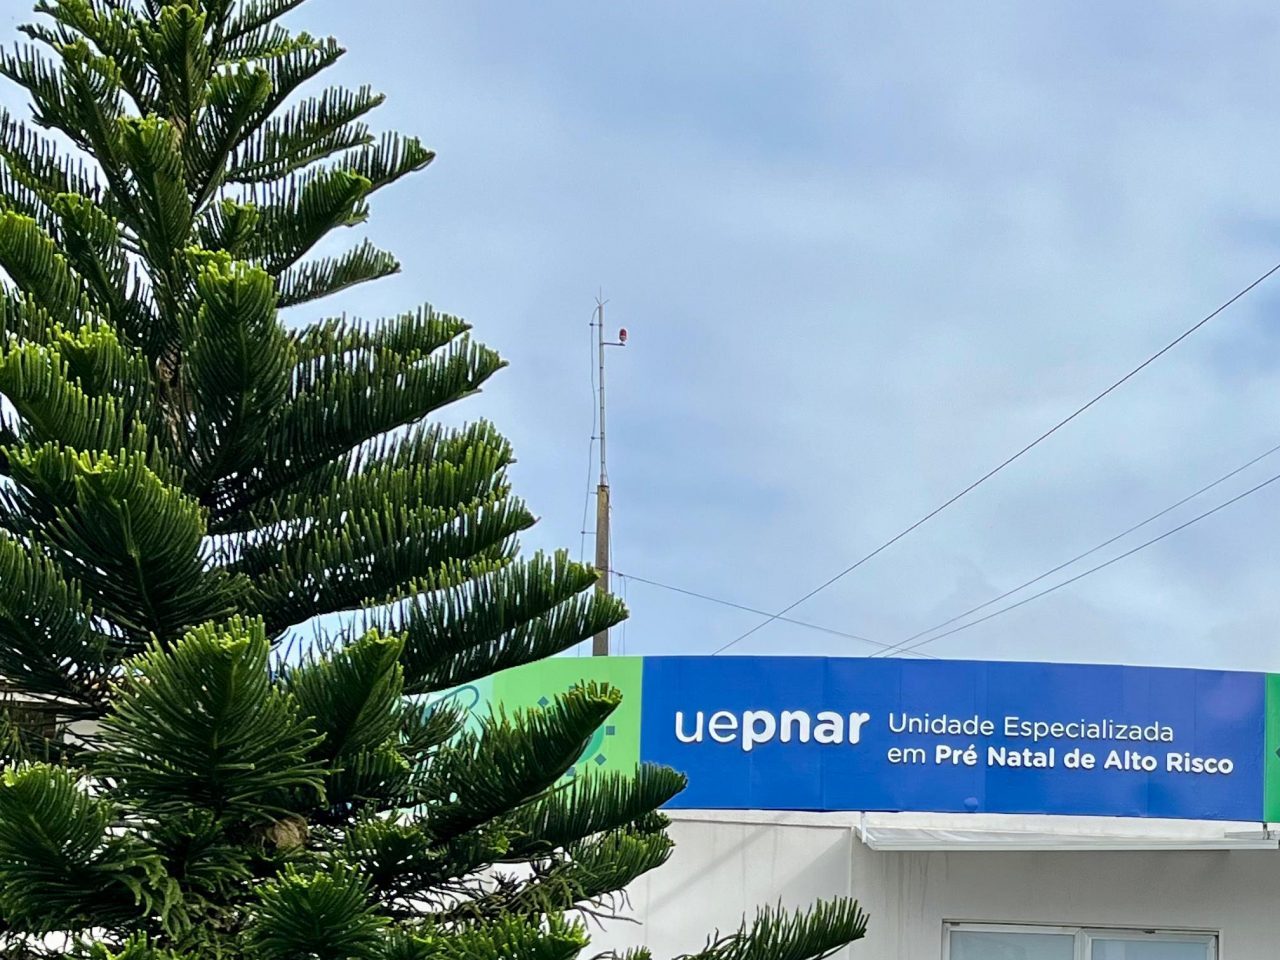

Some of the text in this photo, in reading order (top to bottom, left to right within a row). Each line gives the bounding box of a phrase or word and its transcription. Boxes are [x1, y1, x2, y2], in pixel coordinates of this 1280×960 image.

[675, 710, 870, 751] uepnar
[889, 713, 1174, 742] Unidade Especializada
[887, 744, 1234, 774] em Pré Natal de Alto Risco
